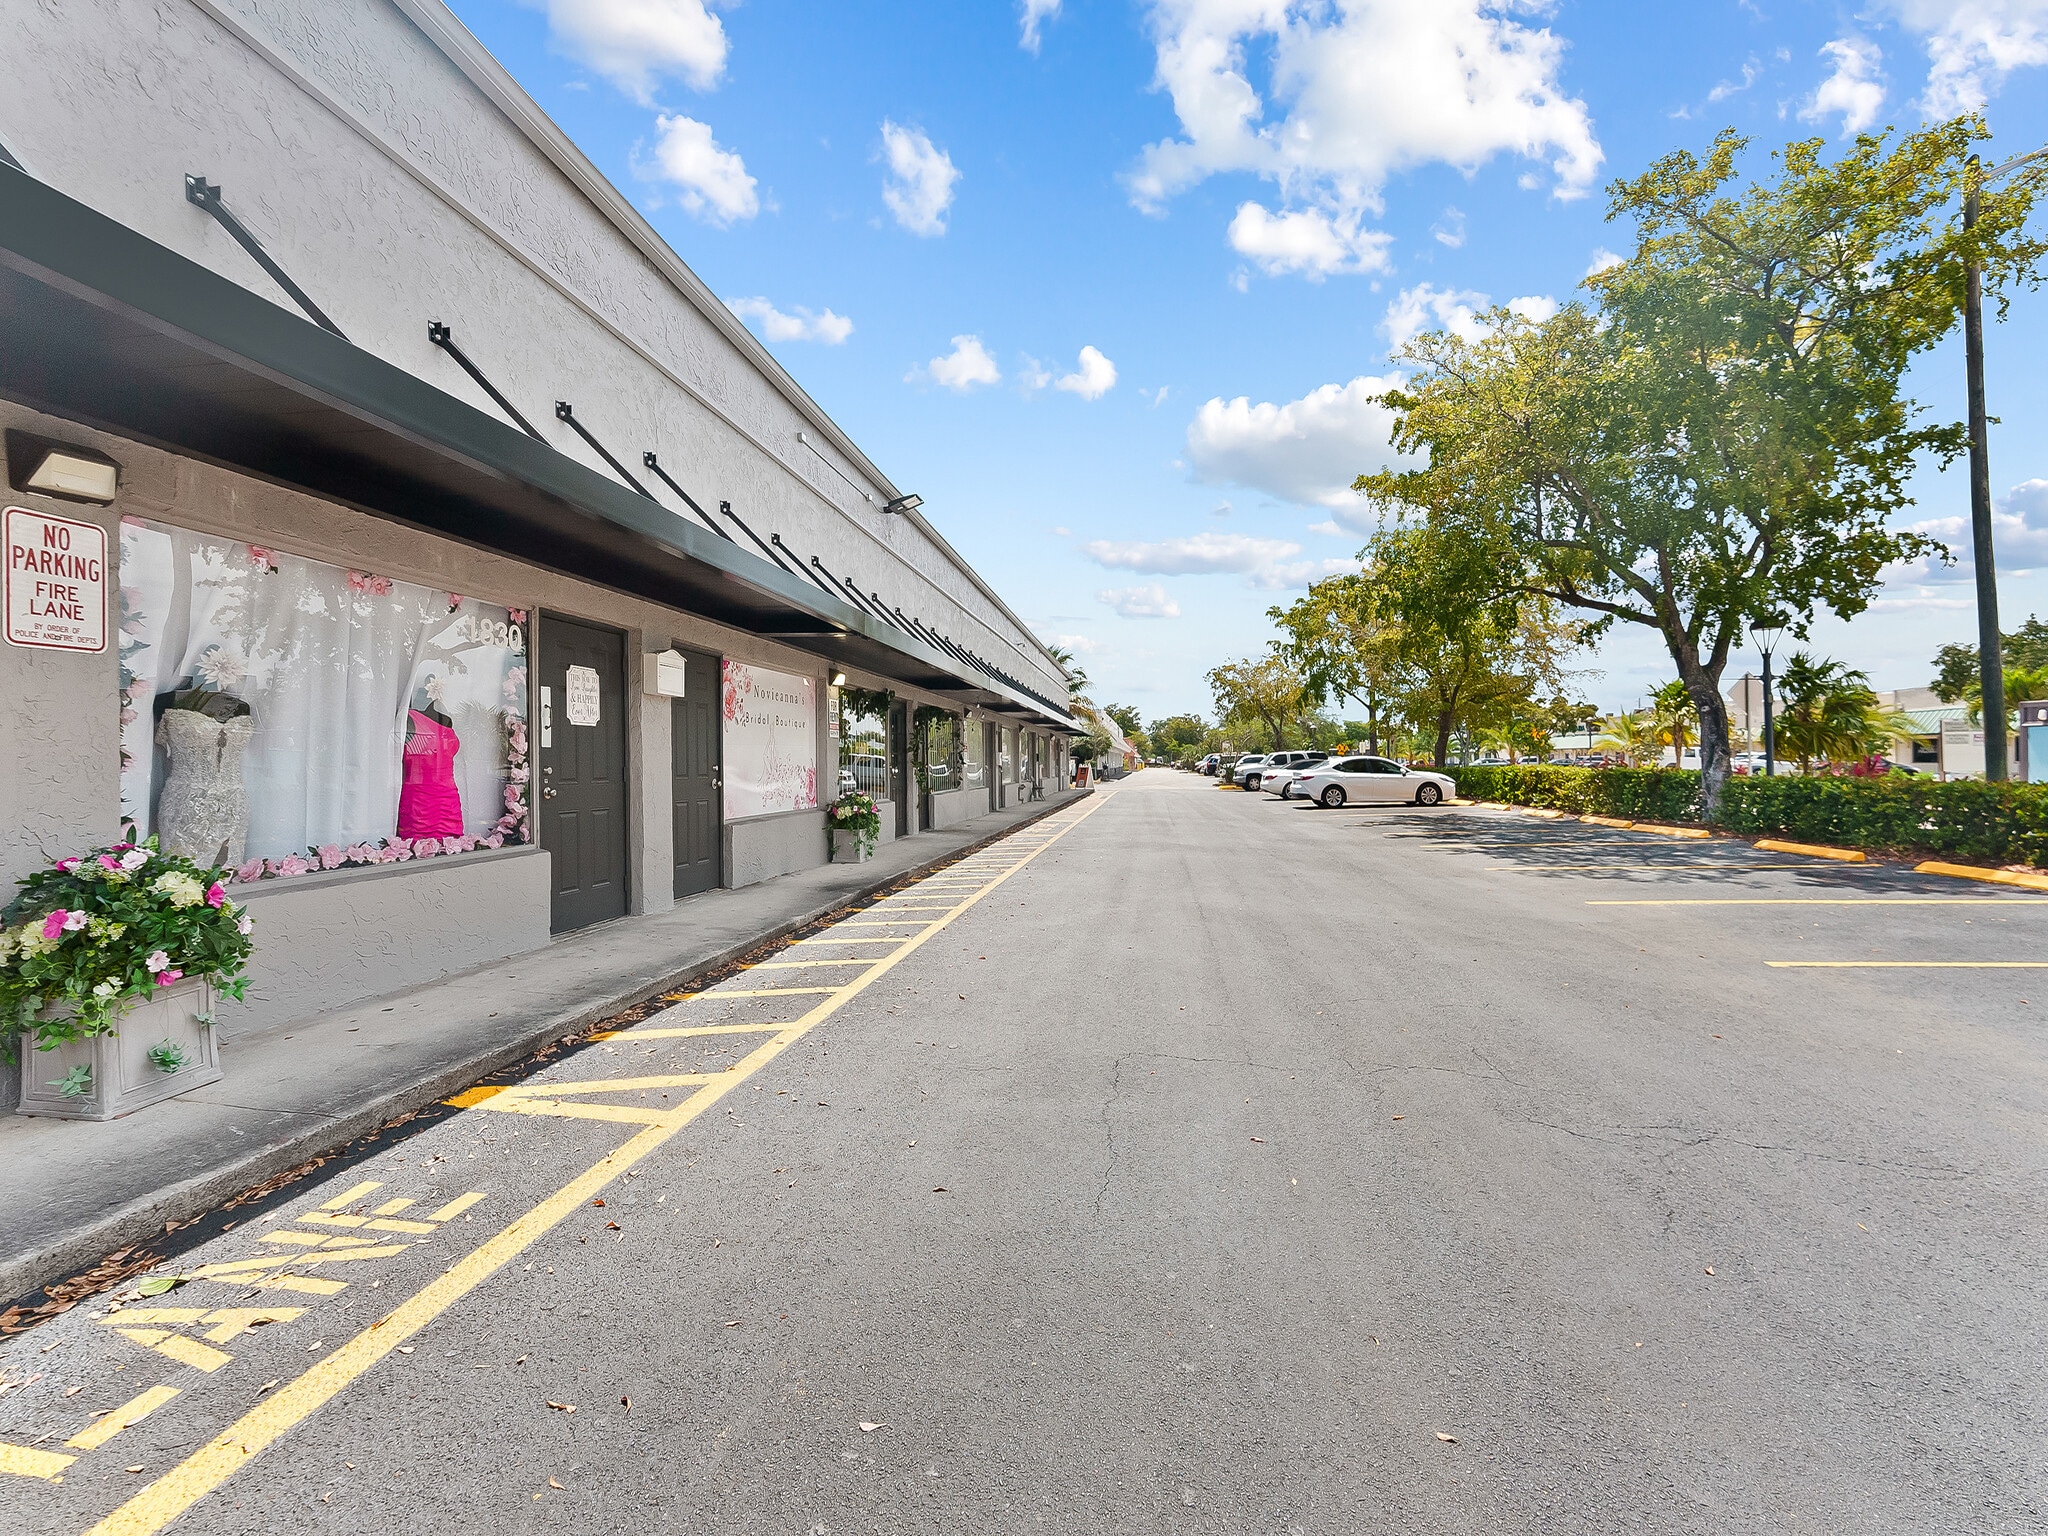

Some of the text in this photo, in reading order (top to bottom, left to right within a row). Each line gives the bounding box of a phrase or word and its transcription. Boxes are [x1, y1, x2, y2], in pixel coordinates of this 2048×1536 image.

[44, 524, 70, 551] NO
[12, 544, 100, 582] PARKING
[36, 581, 79, 602] FIRE
[30, 599, 85, 621] LANE
[14, 629, 39, 639] POLICE
[47, 624, 69, 633] ORDER
[72, 627, 81, 635] OF
[468, 616, 522, 652] 1830
[753, 685, 805, 705] Novieanna's
[775, 715, 806, 730] Boutique
